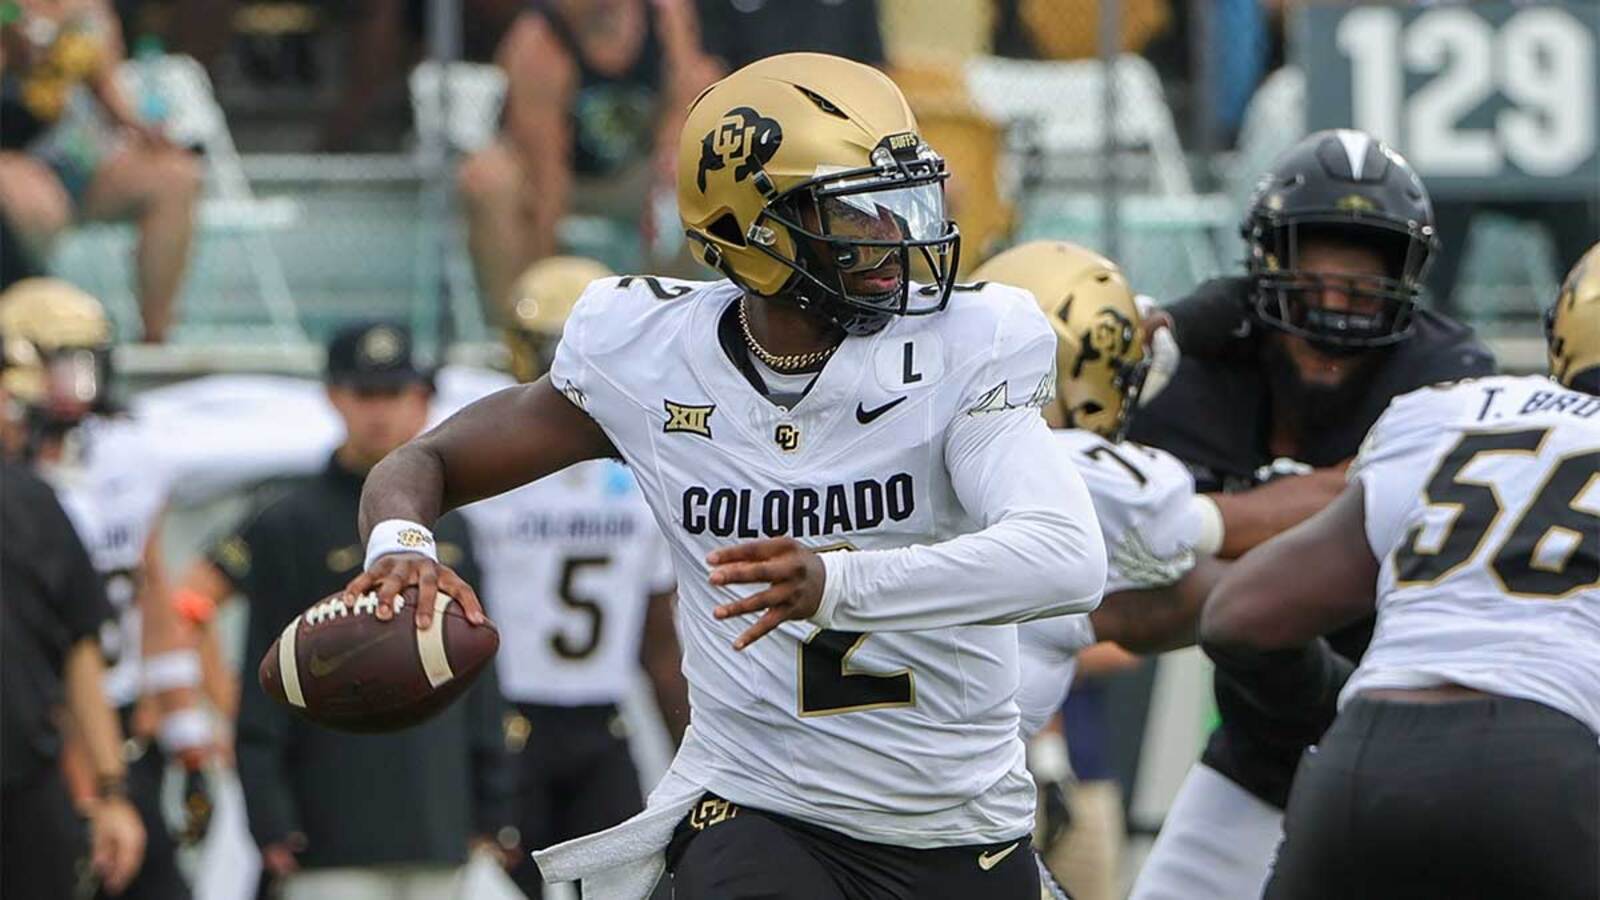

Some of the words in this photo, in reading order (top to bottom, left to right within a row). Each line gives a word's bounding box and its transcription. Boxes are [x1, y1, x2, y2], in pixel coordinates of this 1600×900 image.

[1336, 6, 1596, 178] 129
[713, 114, 756, 167] CU
[889, 133, 917, 150] BUFFS
[902, 341, 923, 384] L
[663, 399, 716, 440] XII
[1477, 387, 1504, 421] T.
[682, 472, 915, 539] COLORADO
[1393, 426, 1600, 599] 56
[551, 554, 612, 660] 5
